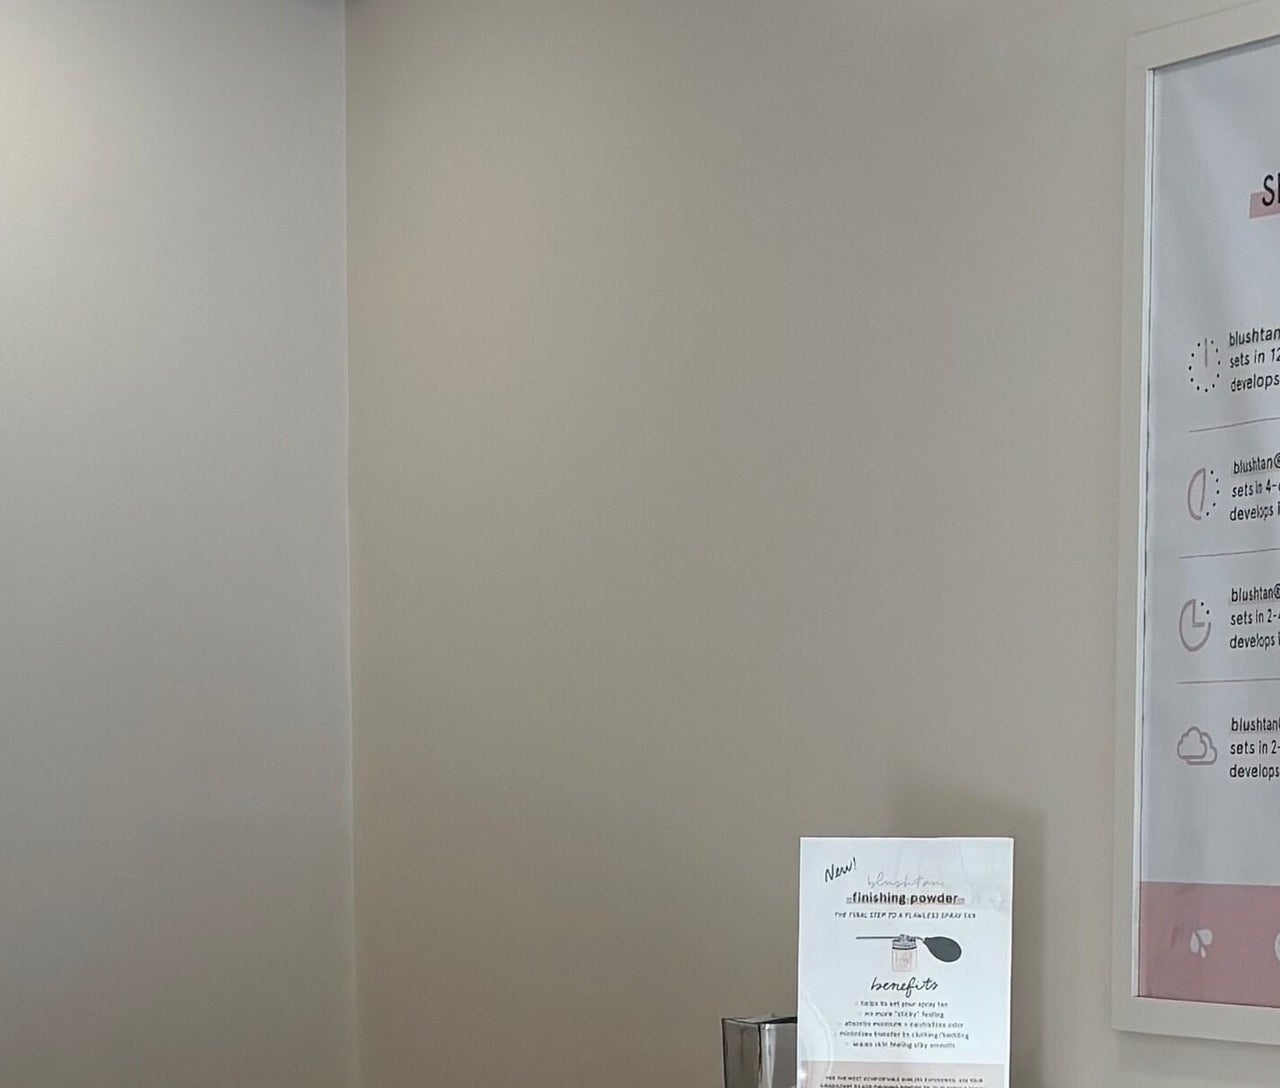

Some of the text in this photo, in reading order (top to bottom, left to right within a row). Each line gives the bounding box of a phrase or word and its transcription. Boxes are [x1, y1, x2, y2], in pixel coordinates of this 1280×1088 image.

[1230, 353, 1250, 368] sets
[1254, 350, 1265, 363] in
[1231, 374, 1280, 392] develops
[1229, 741, 1255, 755] sets
[1259, 741, 1268, 754] in
[1229, 764, 1279, 781] develops
[870, 976, 938, 998] benefits
